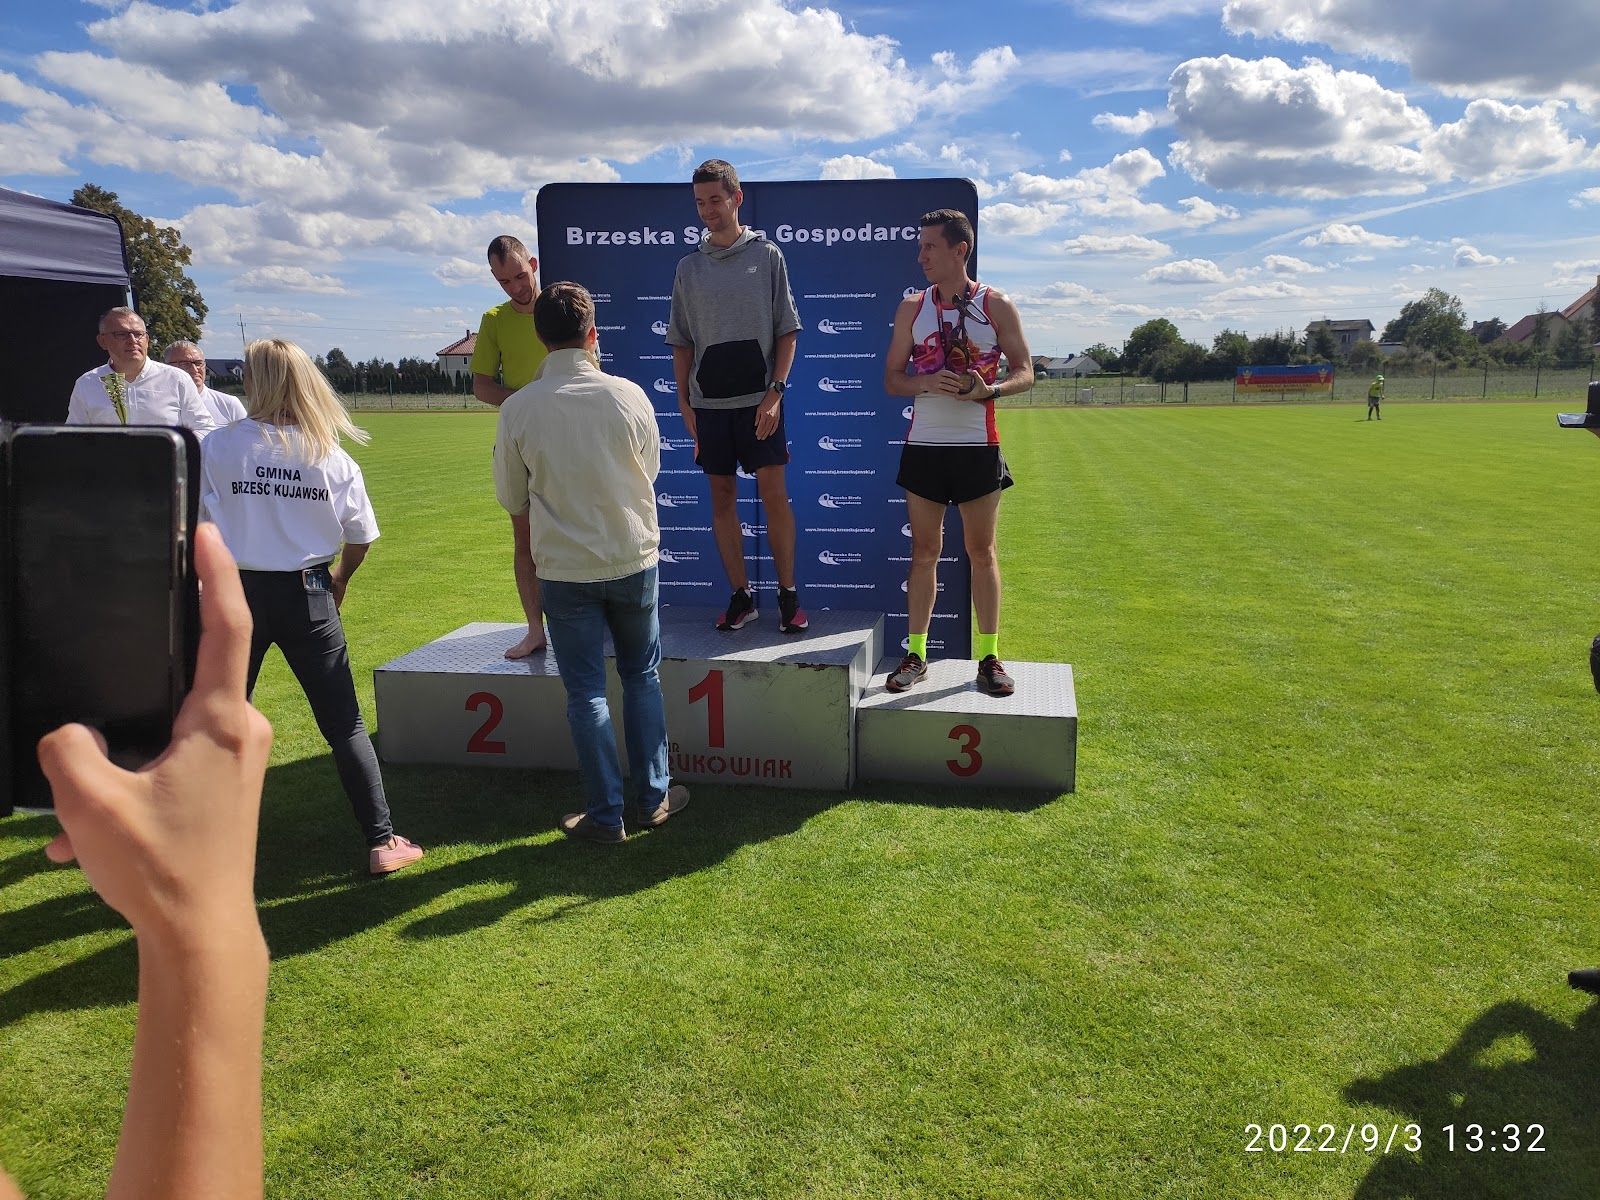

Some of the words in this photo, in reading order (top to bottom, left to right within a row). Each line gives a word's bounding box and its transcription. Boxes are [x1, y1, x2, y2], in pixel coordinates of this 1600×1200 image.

[566, 226, 676, 245] Brzeska
[775, 222, 922, 247] Gospodarc
[255, 466, 302, 482] GMINA
[231, 479, 271, 496] BRZEŚĆ
[274, 484, 329, 502] KUJAWSKI
[465, 691, 507, 754] 2
[688, 669, 725, 749] 1
[946, 724, 983, 777] 3
[668, 752, 793, 779] UKOWIAK
